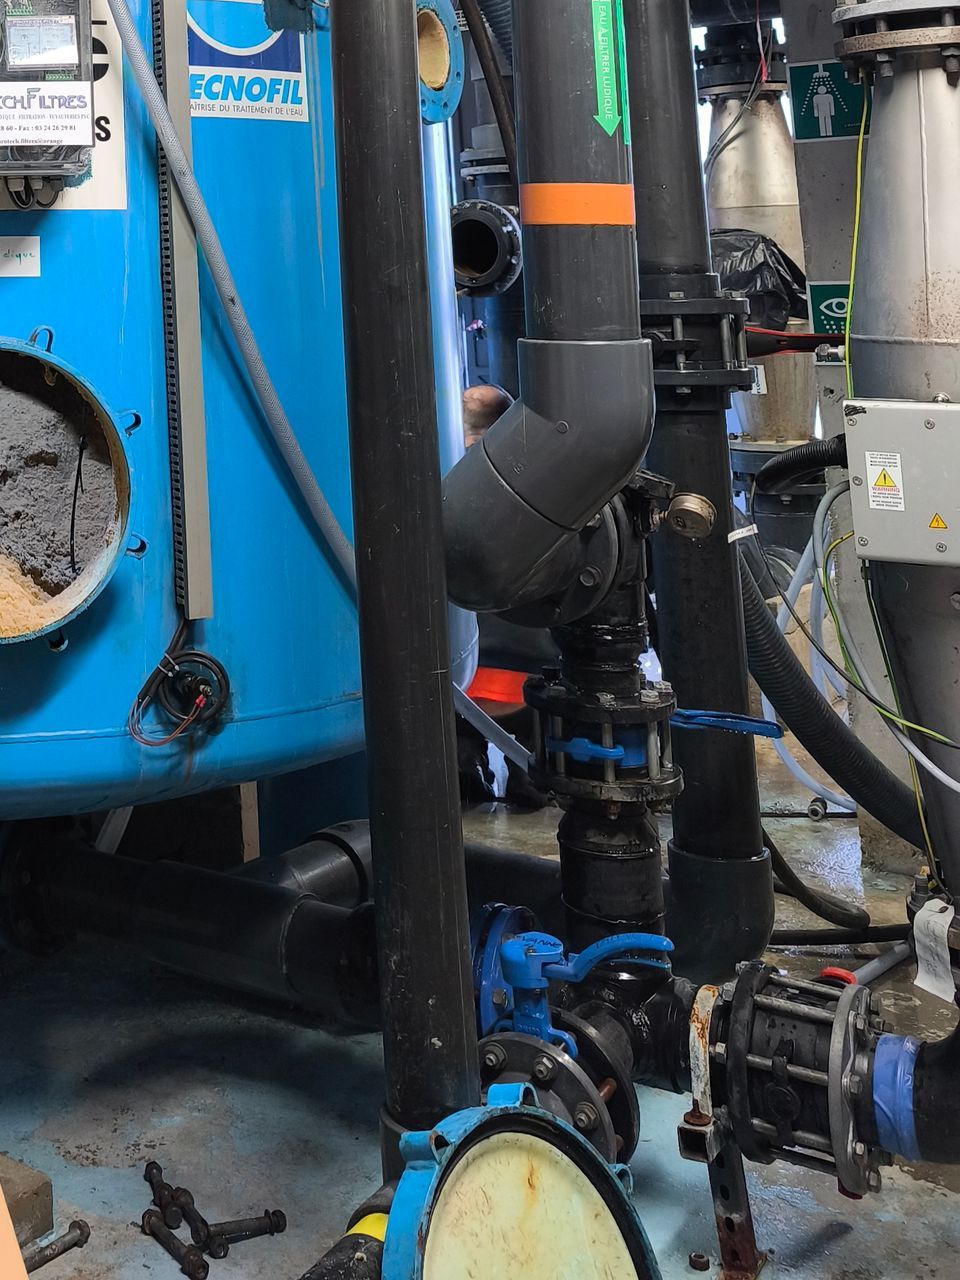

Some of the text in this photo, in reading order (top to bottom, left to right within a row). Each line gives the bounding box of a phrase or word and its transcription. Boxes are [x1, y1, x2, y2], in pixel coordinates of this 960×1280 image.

[598, 5, 607, 26] EAU
[601, 37, 610, 72] FILTRER
[189, 73, 303, 105] ECNOFIL
[602, 75, 614, 120] LUDIQUE
[190, 102, 216, 112] AÎTRISE
[219, 104, 230, 112] DU
[232, 104, 274, 114] TRAITEMENT
[275, 107, 284, 115] DE
